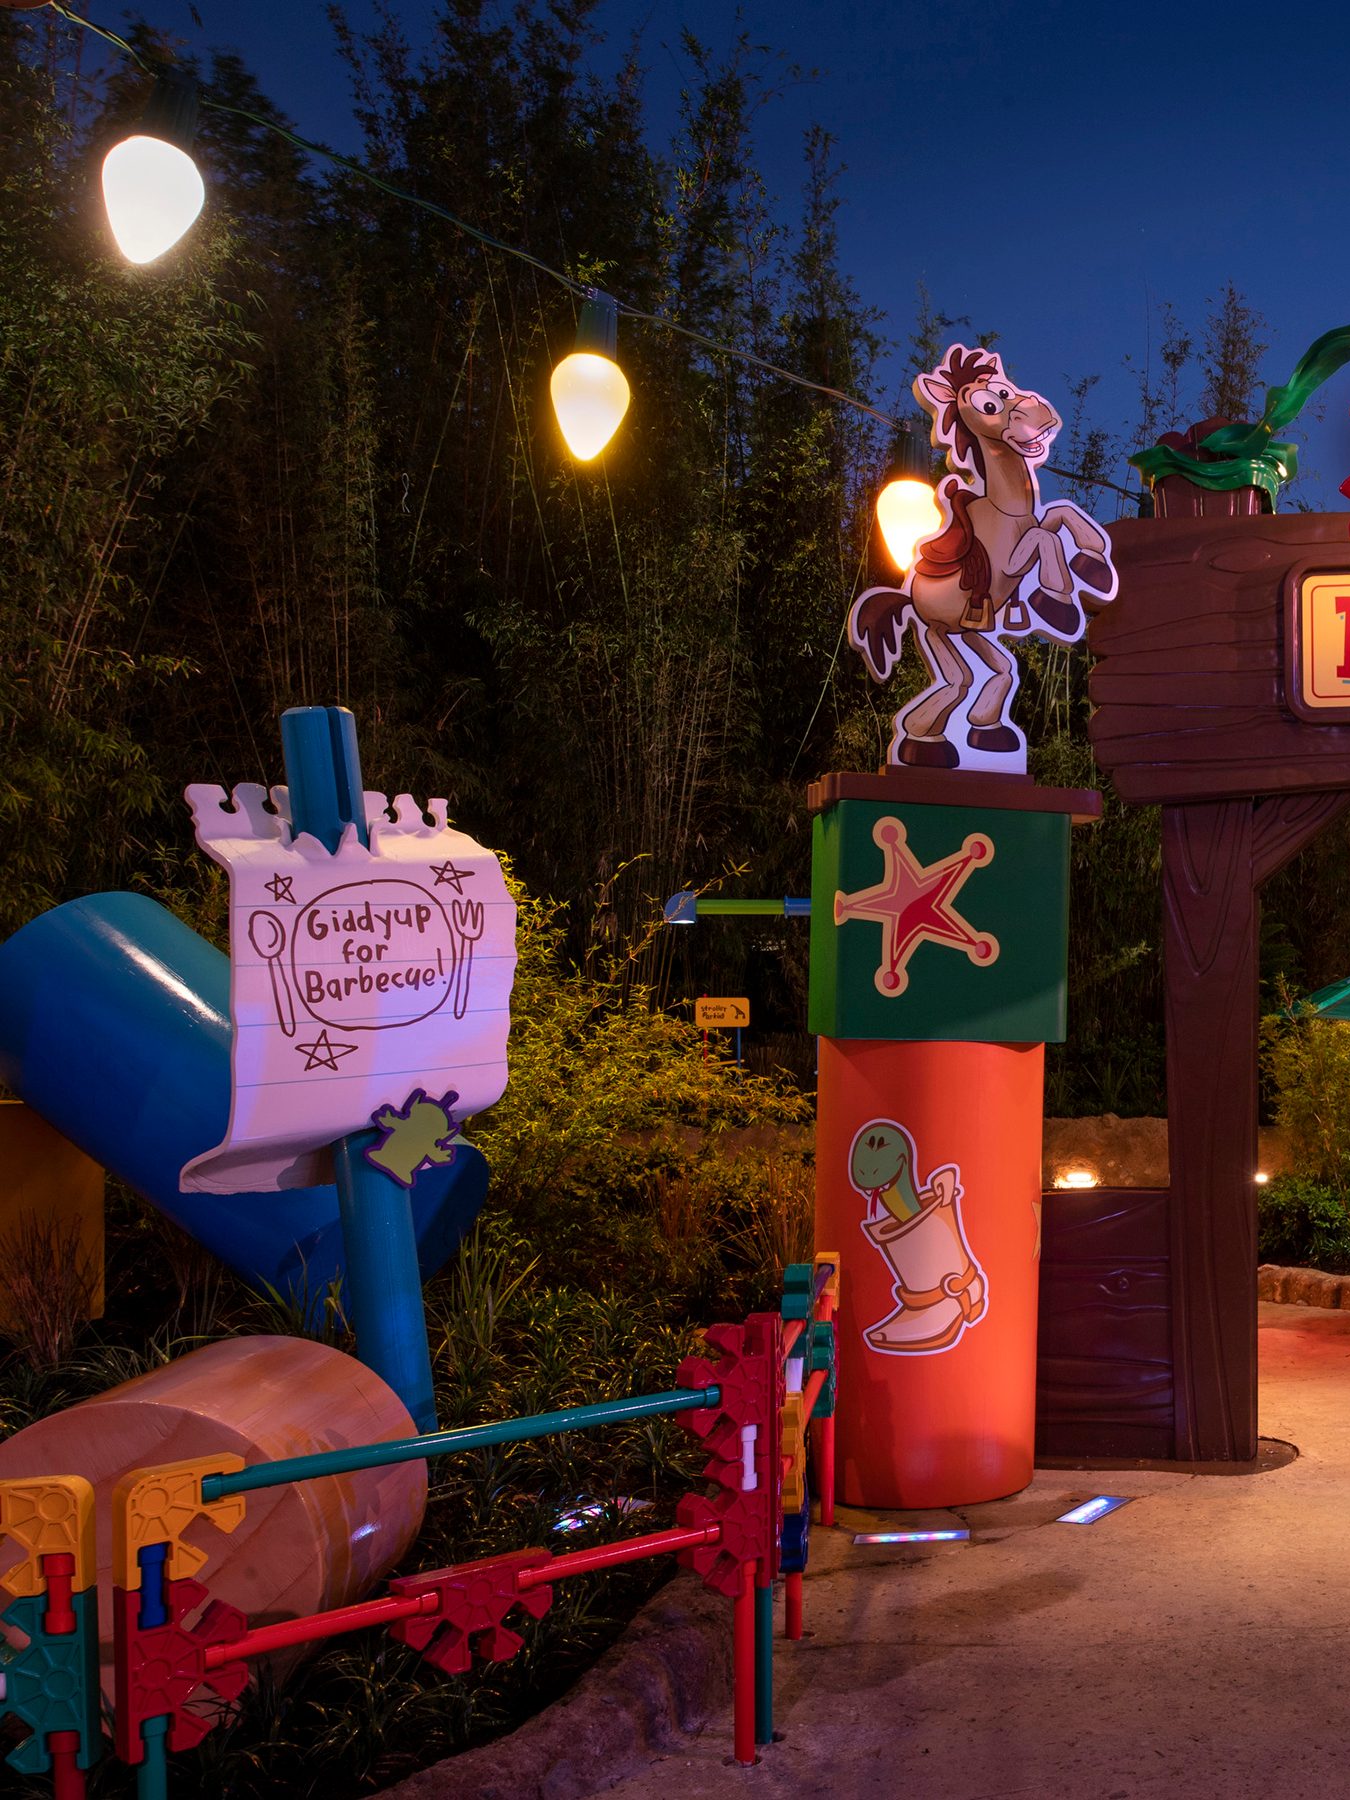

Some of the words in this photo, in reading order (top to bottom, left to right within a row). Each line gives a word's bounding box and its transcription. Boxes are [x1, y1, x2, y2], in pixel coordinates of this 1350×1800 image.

[308, 901, 432, 941] Giddyup
[342, 940, 389, 964] for
[304, 947, 448, 1004] Barbecue!
